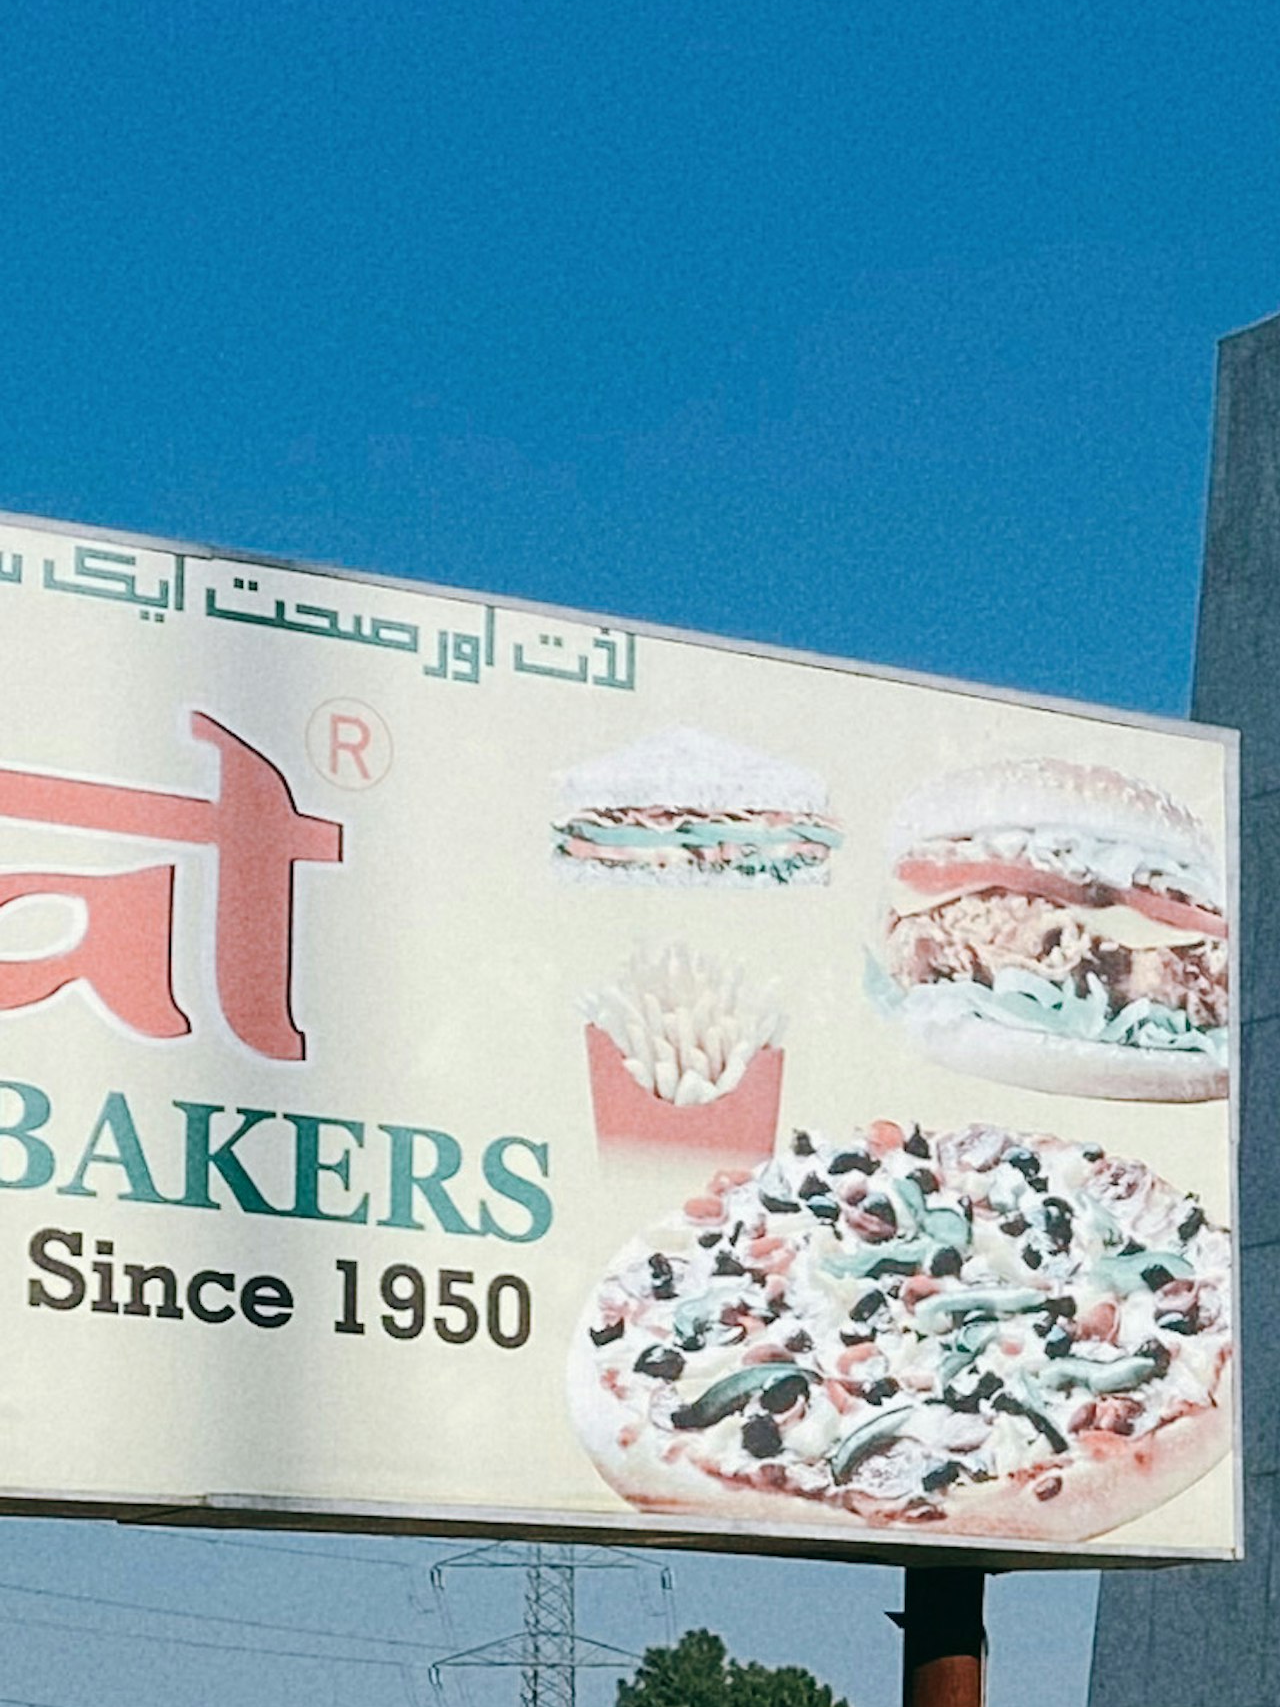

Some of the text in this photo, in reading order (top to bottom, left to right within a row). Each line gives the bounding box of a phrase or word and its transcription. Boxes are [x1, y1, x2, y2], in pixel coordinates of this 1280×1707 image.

[0, 1080, 554, 1243] BAKERS
[28, 1228, 531, 1349] Since 1950
